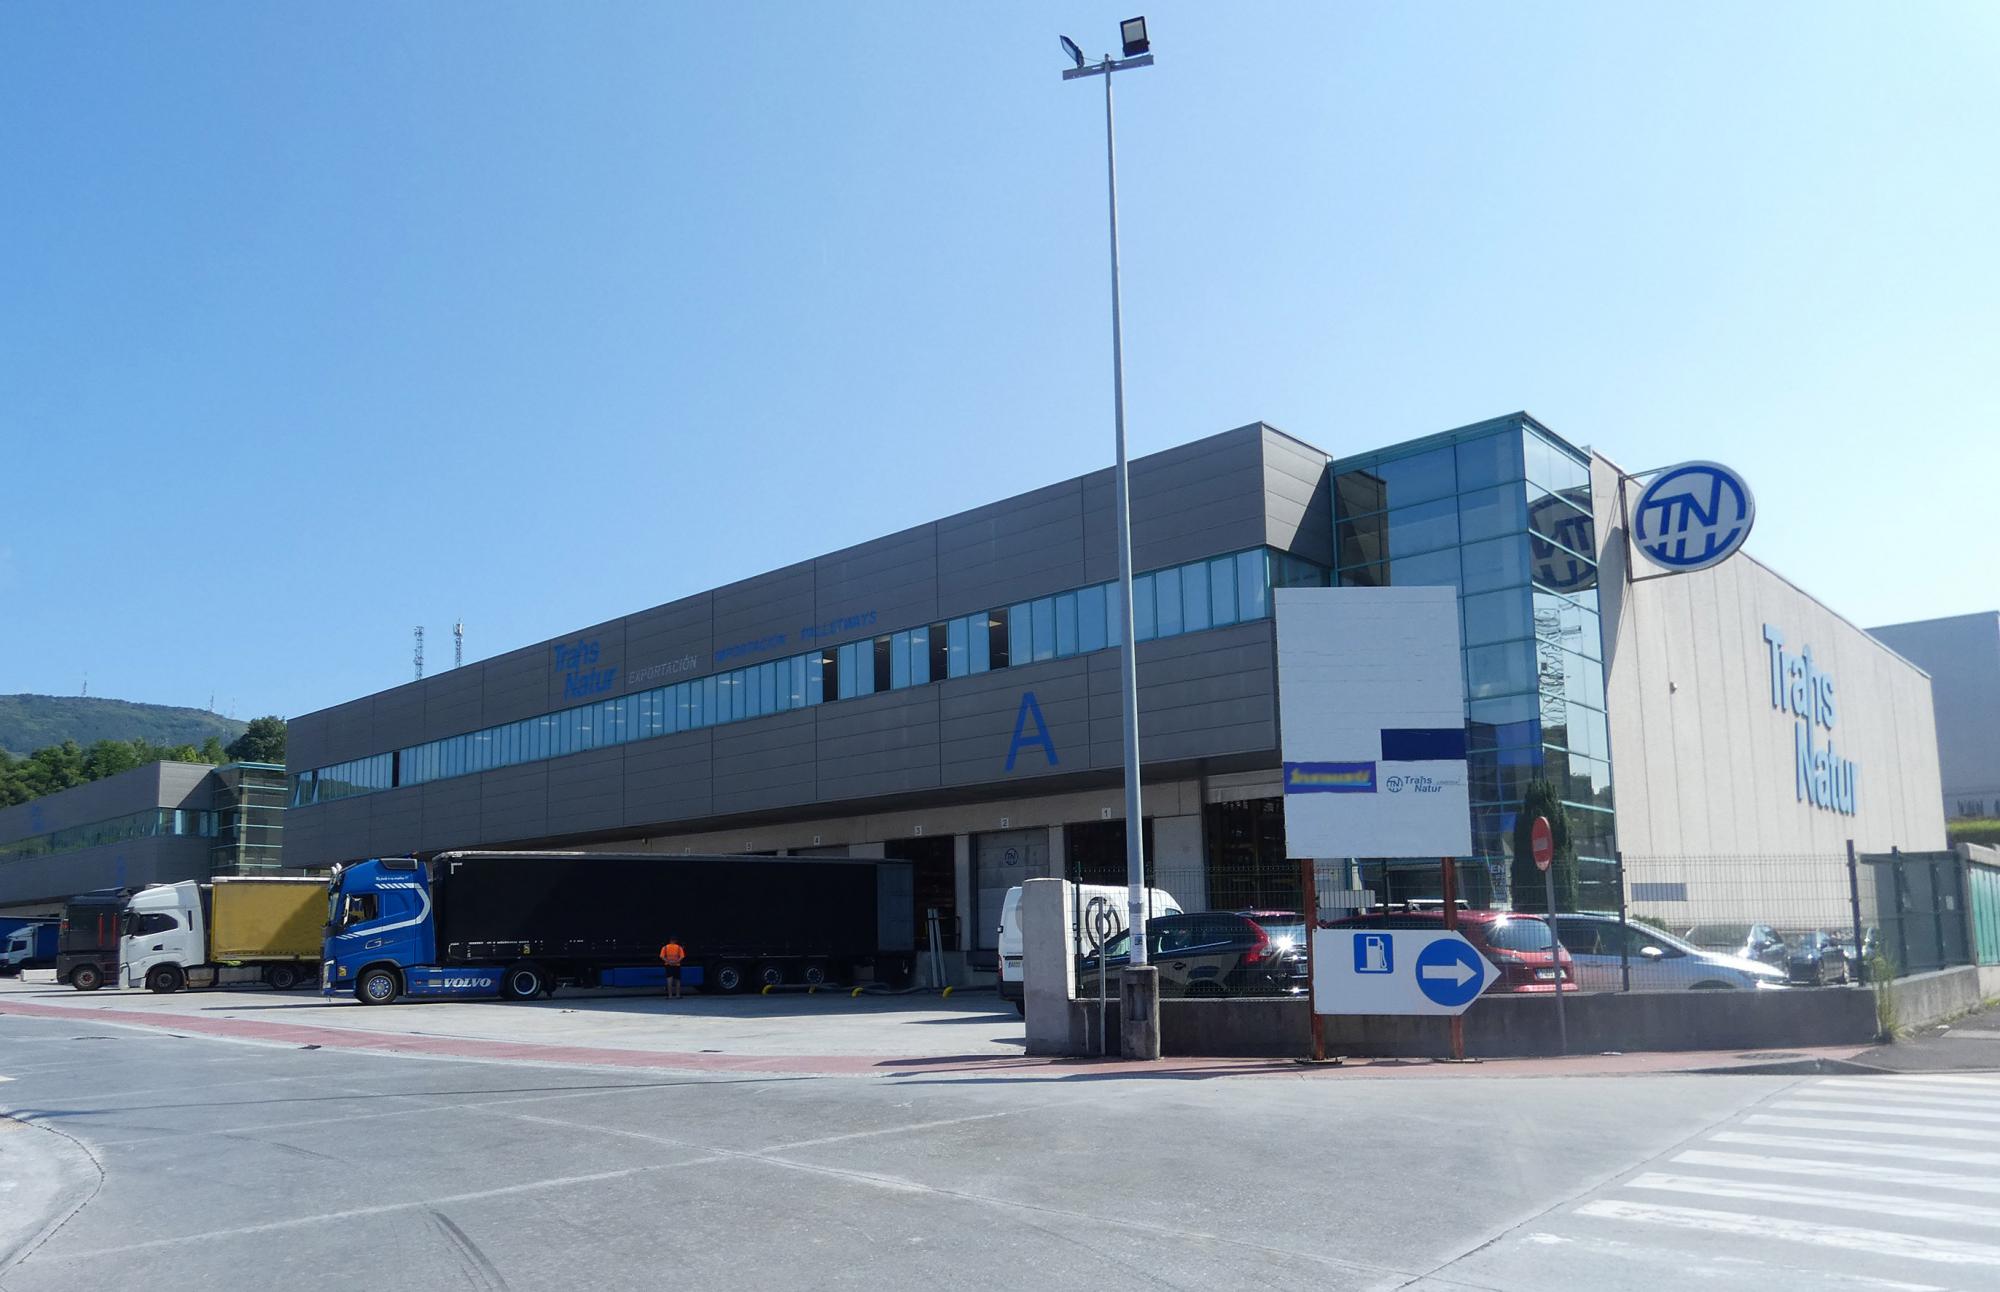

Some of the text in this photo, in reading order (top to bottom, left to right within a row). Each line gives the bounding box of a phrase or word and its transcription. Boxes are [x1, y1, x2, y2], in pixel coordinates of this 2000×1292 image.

[1640, 470, 1732, 563] TN
[563, 665, 619, 700] Natur
[1004, 690, 1060, 773] A
[1414, 783, 1442, 793] Natur
[1794, 721, 1860, 816] Natur
[443, 977, 493, 988] VOLVO
